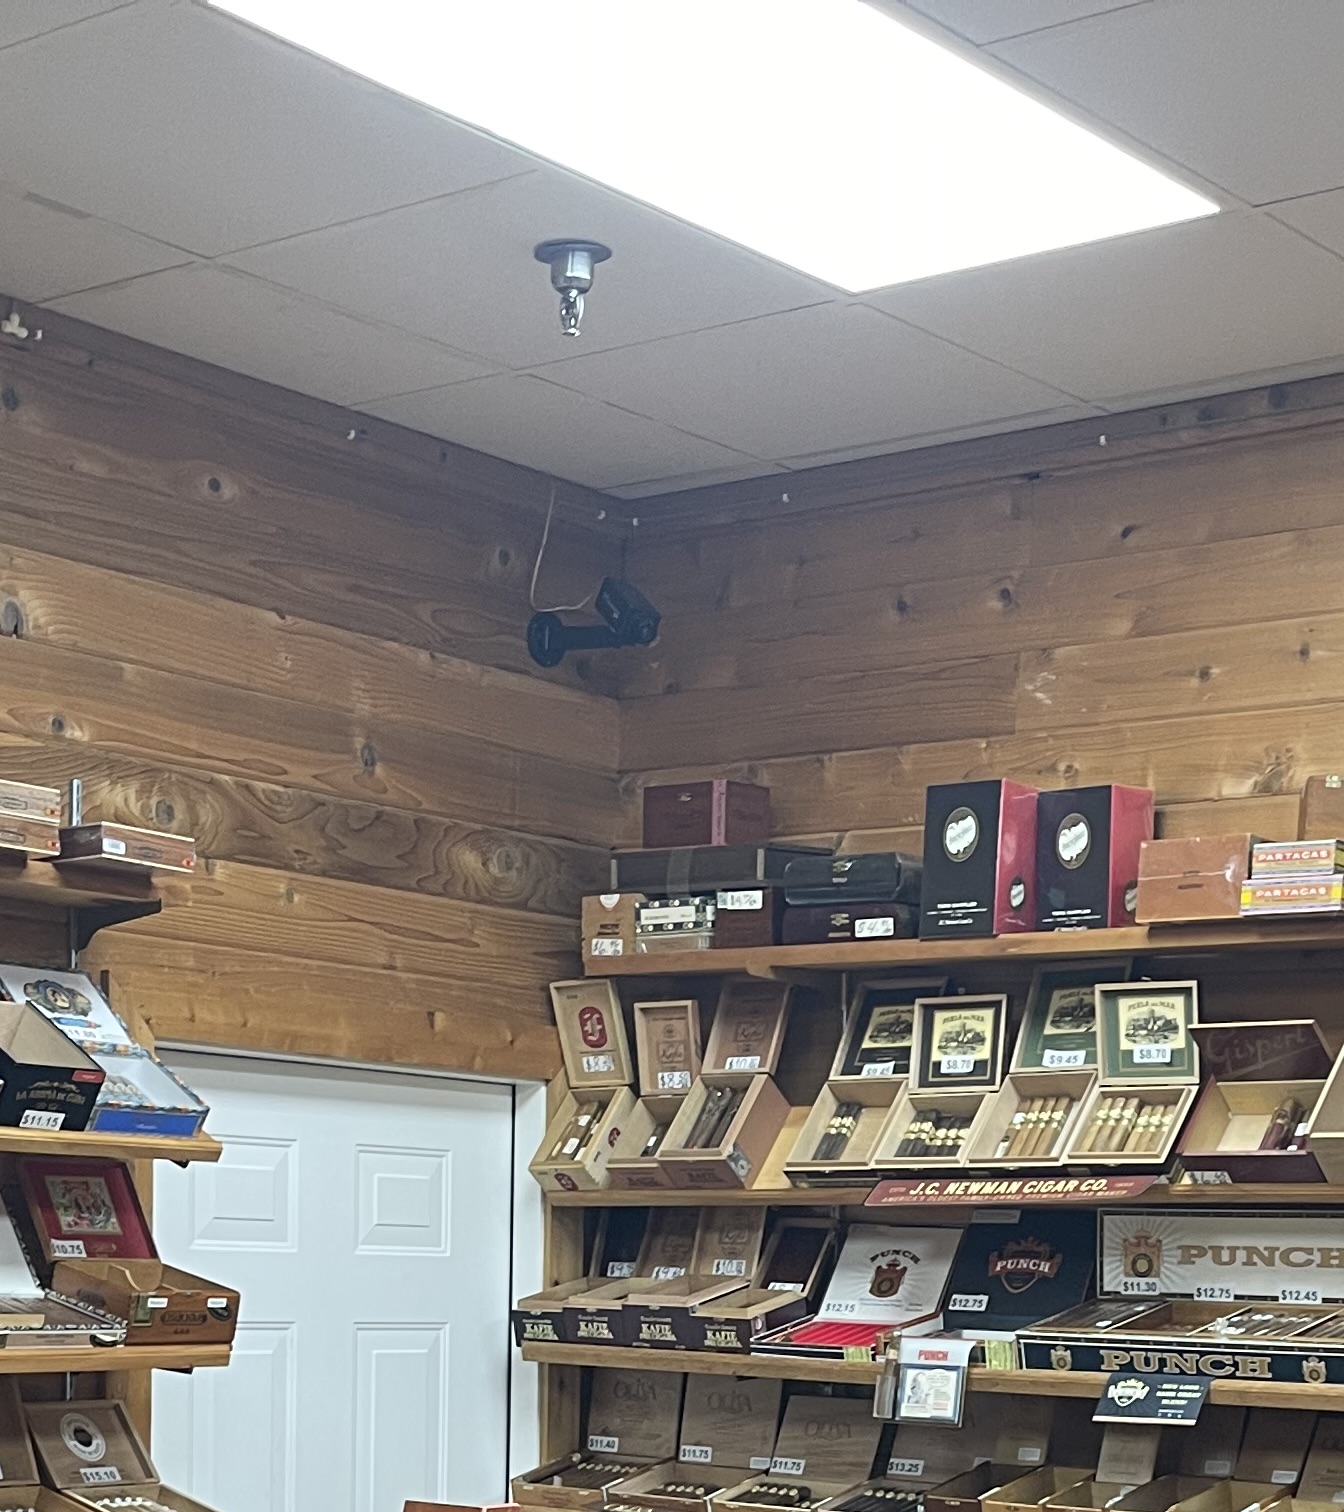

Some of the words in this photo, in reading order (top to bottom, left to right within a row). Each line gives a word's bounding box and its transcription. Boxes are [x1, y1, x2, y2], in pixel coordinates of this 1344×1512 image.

[22, 1114, 59, 1128] $11.15
[910, 1183, 940, 1195] J.C.
[945, 1181, 1019, 1195] NEWMAN
[1022, 1181, 1075, 1194] CIGAR
[1079, 1179, 1107, 1192] CO.
[870, 1249, 920, 1265] PUNCH
[995, 1258, 1050, 1273] PUNCH
[1123, 1281, 1157, 1293] $11.30
[1196, 1286, 1232, 1299] $12.75
[1281, 1289, 1318, 1302] $12.45
[951, 1298, 984, 1308] $12.75
[1101, 1349, 1272, 1378] PUNCH
[682, 1447, 710, 1459] $11.75
[773, 1459, 803, 1471] $11.75
